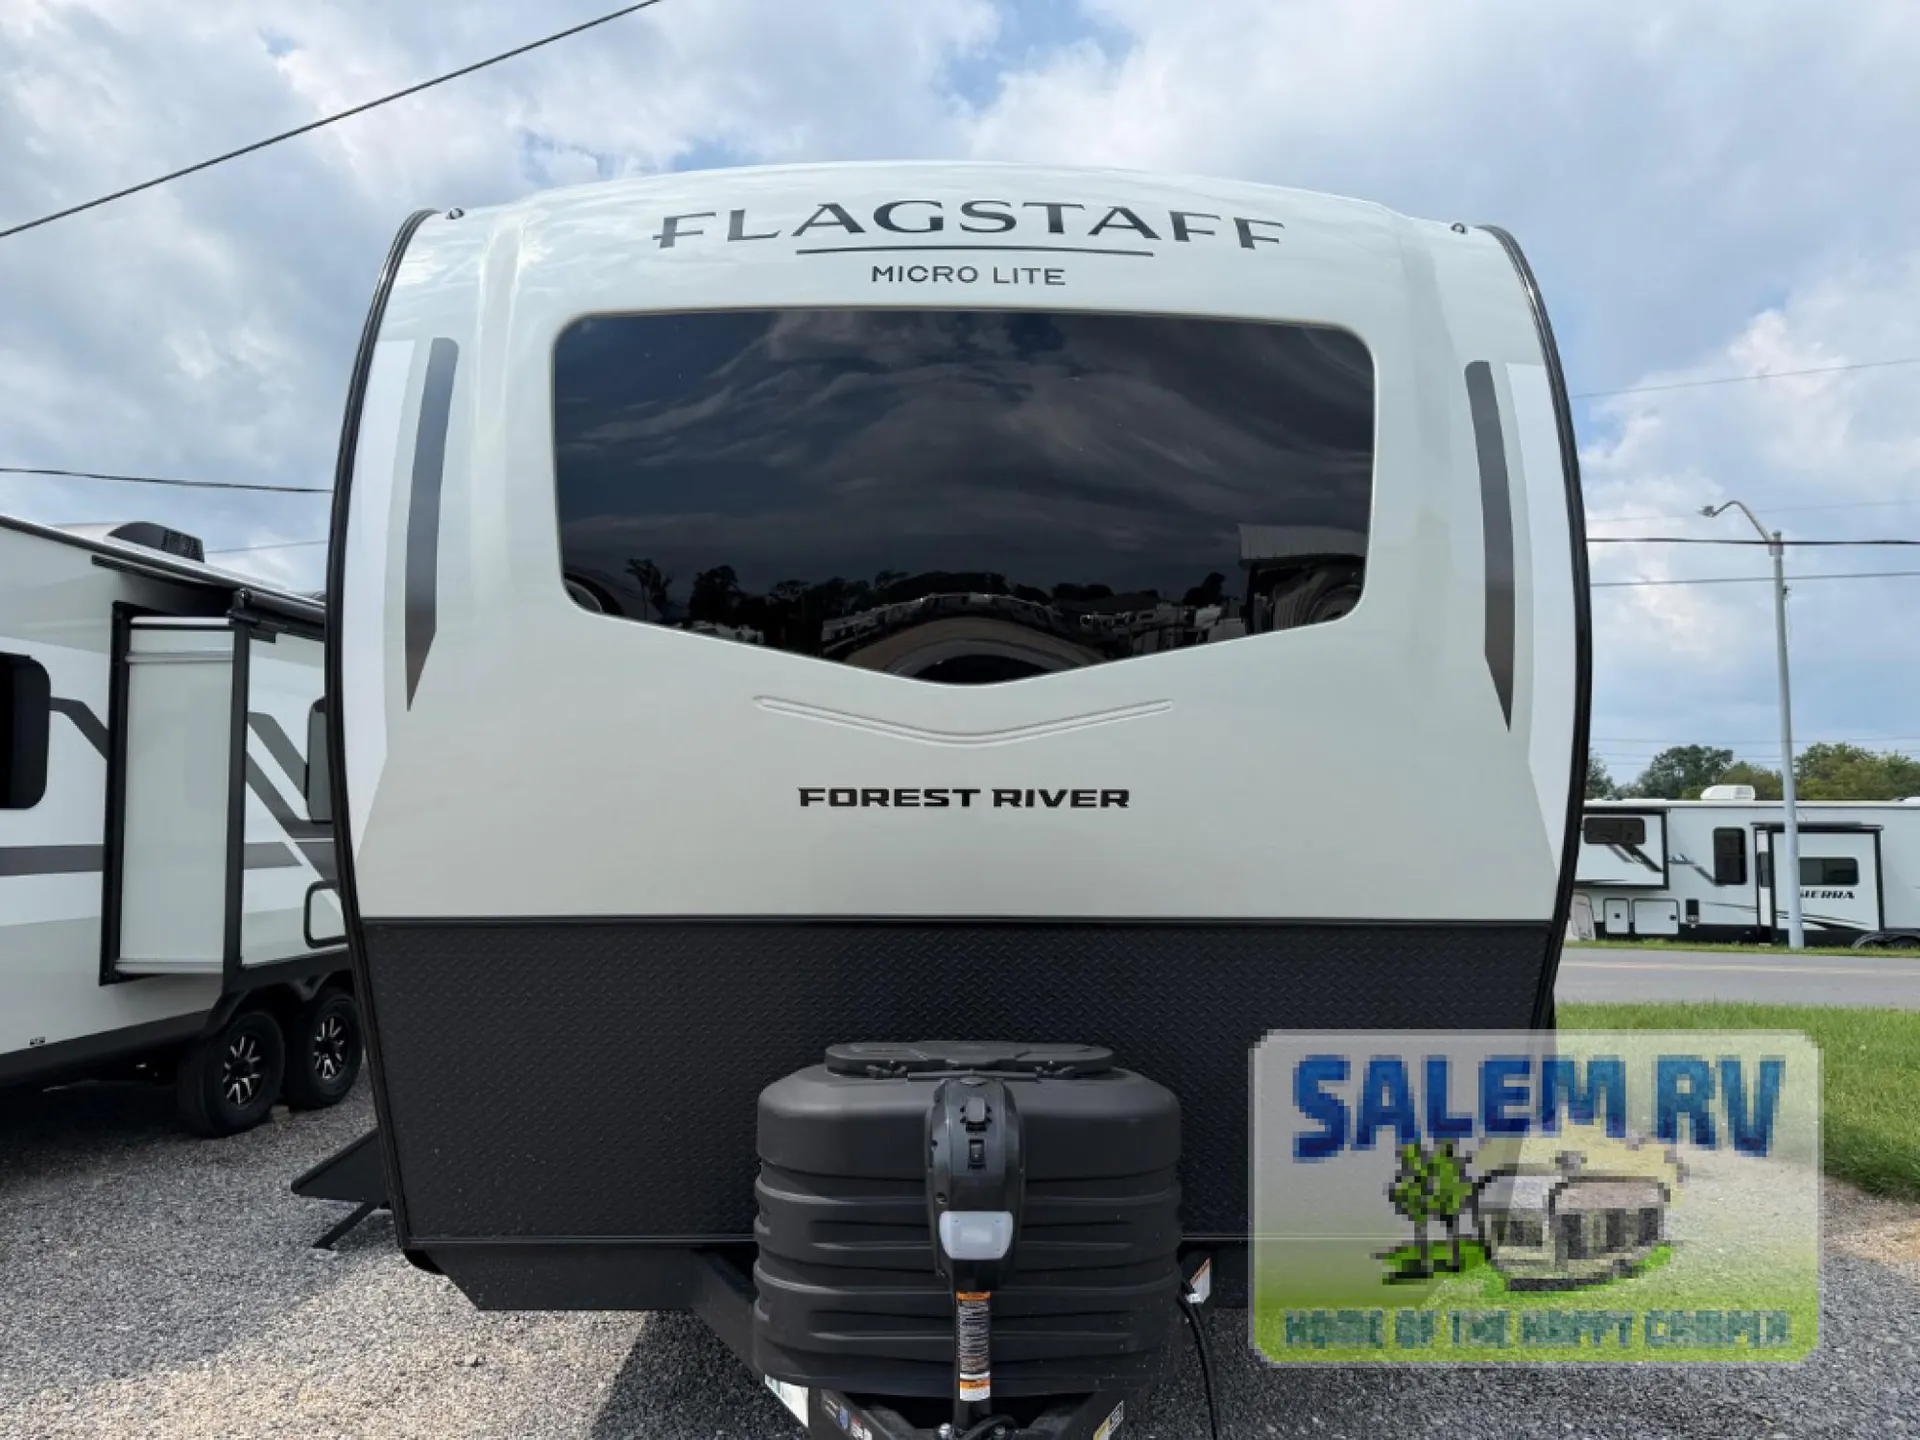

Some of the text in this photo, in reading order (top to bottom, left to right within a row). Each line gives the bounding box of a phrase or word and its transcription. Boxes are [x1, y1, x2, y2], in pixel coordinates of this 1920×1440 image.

[652, 200, 1285, 250] FLAGSTAFF
[871, 265, 1067, 286] MICRO LITE
[797, 787, 1131, 809] FOREST RIVER
